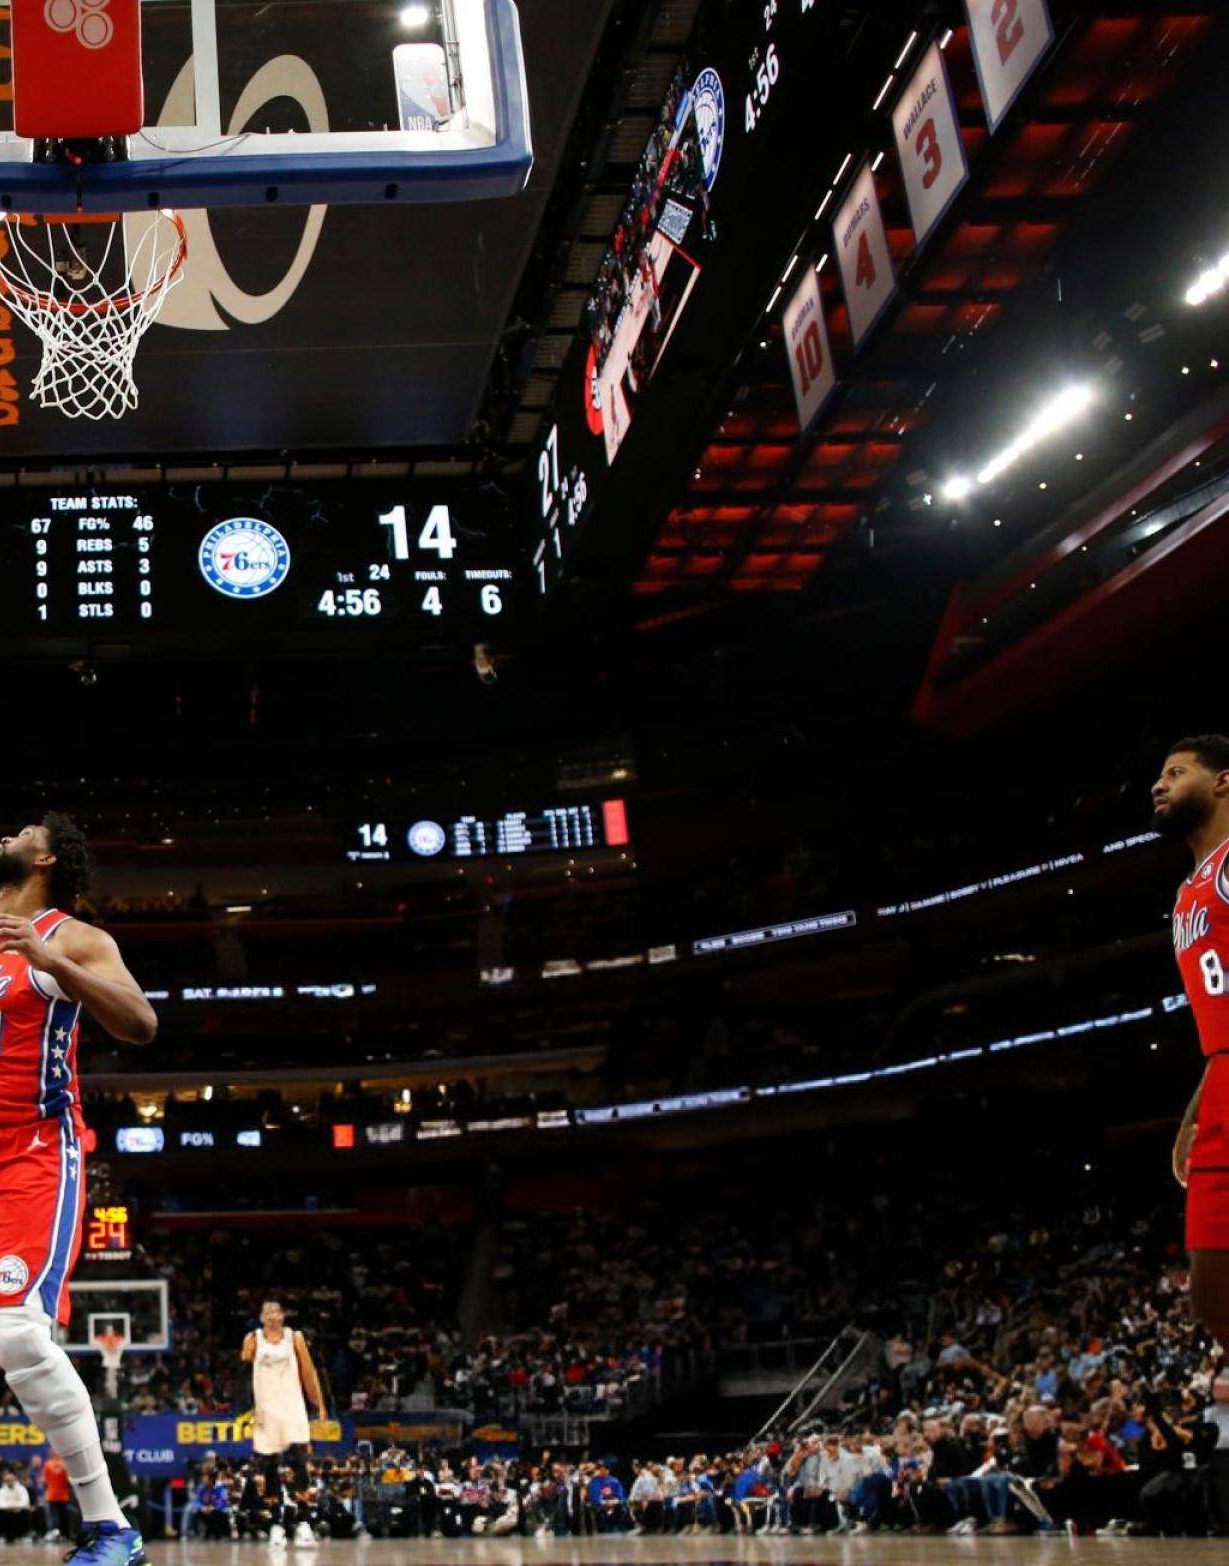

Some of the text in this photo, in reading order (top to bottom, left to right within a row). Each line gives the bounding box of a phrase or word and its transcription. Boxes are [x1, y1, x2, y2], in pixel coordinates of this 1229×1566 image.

[744, 43, 780, 133] 4:56
[903, 78, 938, 141] WALLACE
[407, 115, 434, 131] NBA
[915, 117, 942, 190] 3
[855, 230, 876, 290] 4
[795, 320, 823, 398] 10
[538, 423, 560, 518] 27
[51, 495, 138, 510] TEAM STATS:
[30, 515, 154, 534] 67 FG% 46
[378, 505, 457, 559] 14
[35, 536, 150, 555] 9 REBS 5
[203, 520, 287, 558] PHILADELPHIA
[35, 558, 150, 577] 9 ASTS 3
[219, 550, 271, 571] 76ers
[337, 564, 391, 583] 1st 24
[414, 569, 513, 582] FOULS: TIMEOUTS:
[36, 580, 151, 599] 0 BLKS 0
[421, 586, 443, 616] 4
[481, 584, 503, 615] 6
[37, 601, 152, 620] 1 STLS 0
[318, 588, 382, 617] 4:56
[358, 823, 388, 847] 14
[1199, 949, 1224, 995] 8
[180, 1132, 214, 1147] FG%
[89, 1222, 126, 1249] 24
[136, 1450, 175, 1465] CLUB
